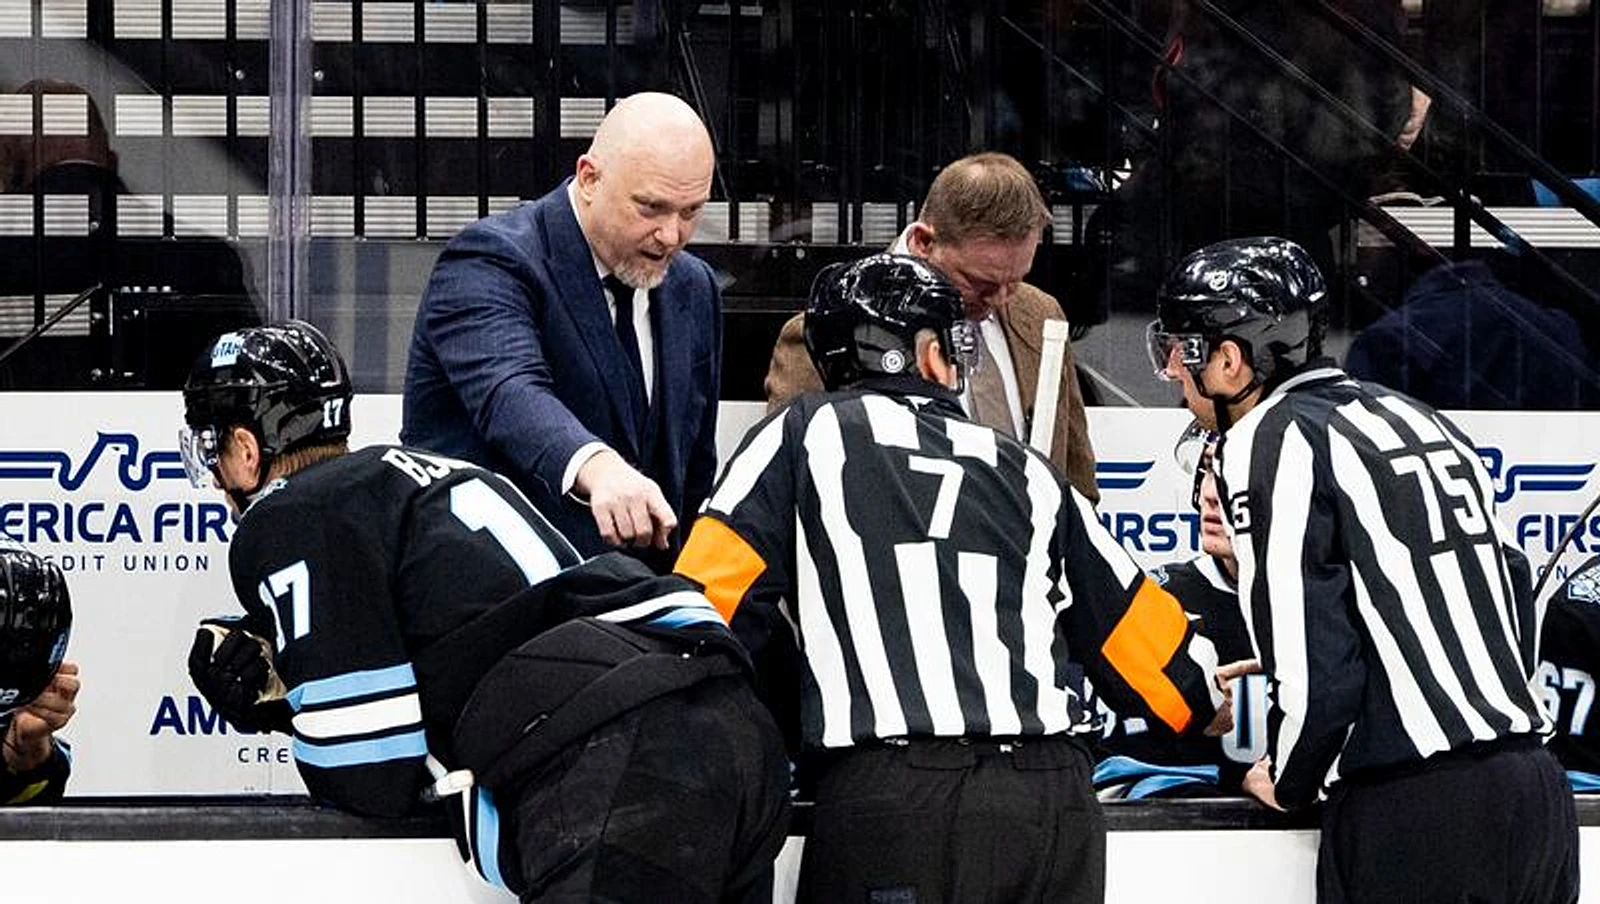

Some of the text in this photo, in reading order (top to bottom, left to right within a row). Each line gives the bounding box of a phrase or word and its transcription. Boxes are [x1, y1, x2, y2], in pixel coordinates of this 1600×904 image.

[323, 398, 344, 428] 17
[381, 448, 482, 488] BJ
[909, 455, 965, 539] 7
[1389, 449, 1488, 543] 75
[153, 503, 239, 542] FIR
[44, 555, 210, 571] DIT UNION
[1528, 660, 1596, 736] 67
